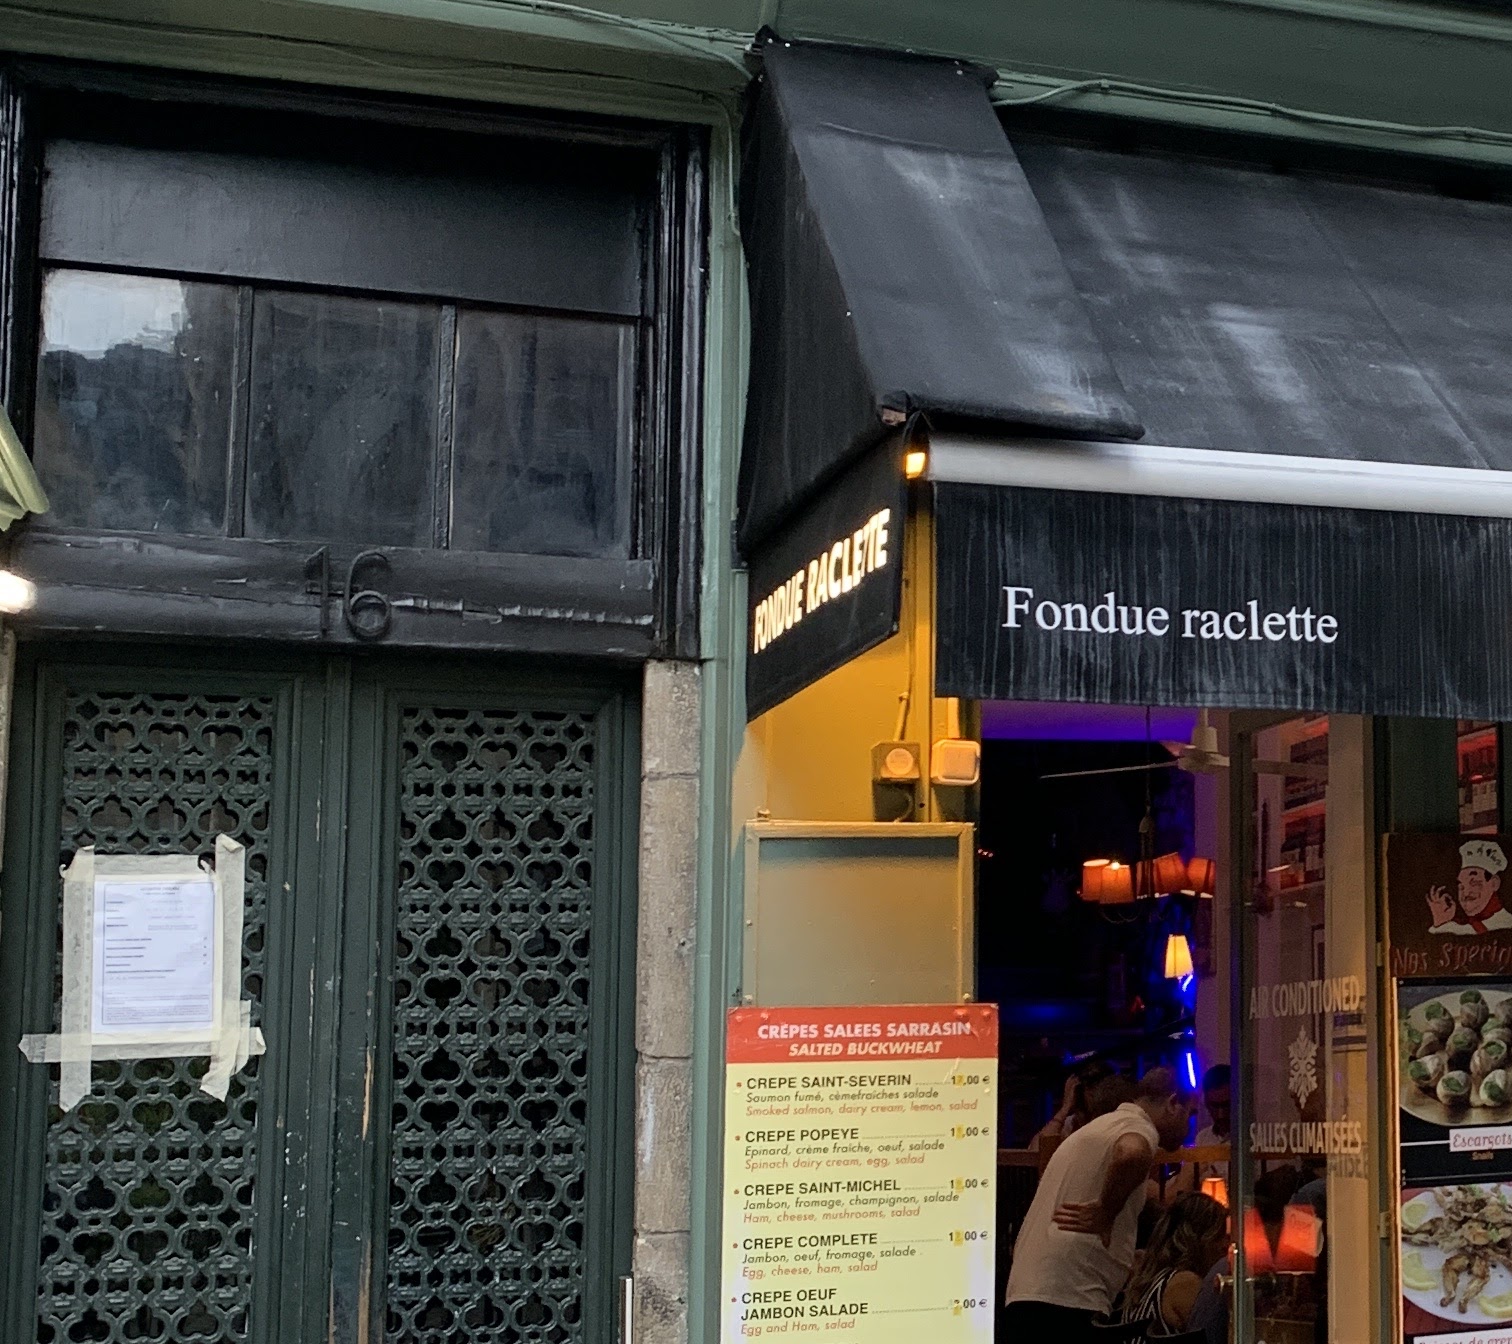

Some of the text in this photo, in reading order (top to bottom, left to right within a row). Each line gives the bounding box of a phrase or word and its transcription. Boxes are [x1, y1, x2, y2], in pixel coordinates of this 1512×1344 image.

[753, 507, 891, 655] FONDUE RACLETTE
[1002, 586, 1338, 644] Fondue raclette
[1249, 975, 1360, 1020] AIR CONDITIONED
[886, 1021, 972, 1038] SARRASIN
[788, 1040, 943, 1057] SALTED BUCKWHEAT
[746, 1073, 912, 1091] CREPE SAINT-SEVERIN
[745, 1091, 792, 1104] Saumon
[902, 1086, 940, 1100] salade
[744, 1127, 860, 1144] CREPE POPEYE
[1250, 1114, 1361, 1154] SALLES CLIMATISÉES
[1453, 1129, 1512, 1150] Escargots
[908, 1139, 946, 1152] salade
[743, 1178, 902, 1198] CREPE SAINT-MICHEL
[742, 1190, 960, 1211] Jambon, fromage, champignon, salade
[742, 1232, 879, 1252] CREPE COMPLETE
[741, 1251, 790, 1265] Jambon,
[825, 1248, 876, 1262] fromage,
[879, 1245, 917, 1259] salade
[740, 1287, 838, 1306] CREPE OEUF
[740, 1301, 869, 1322] JAMBON SALADE
